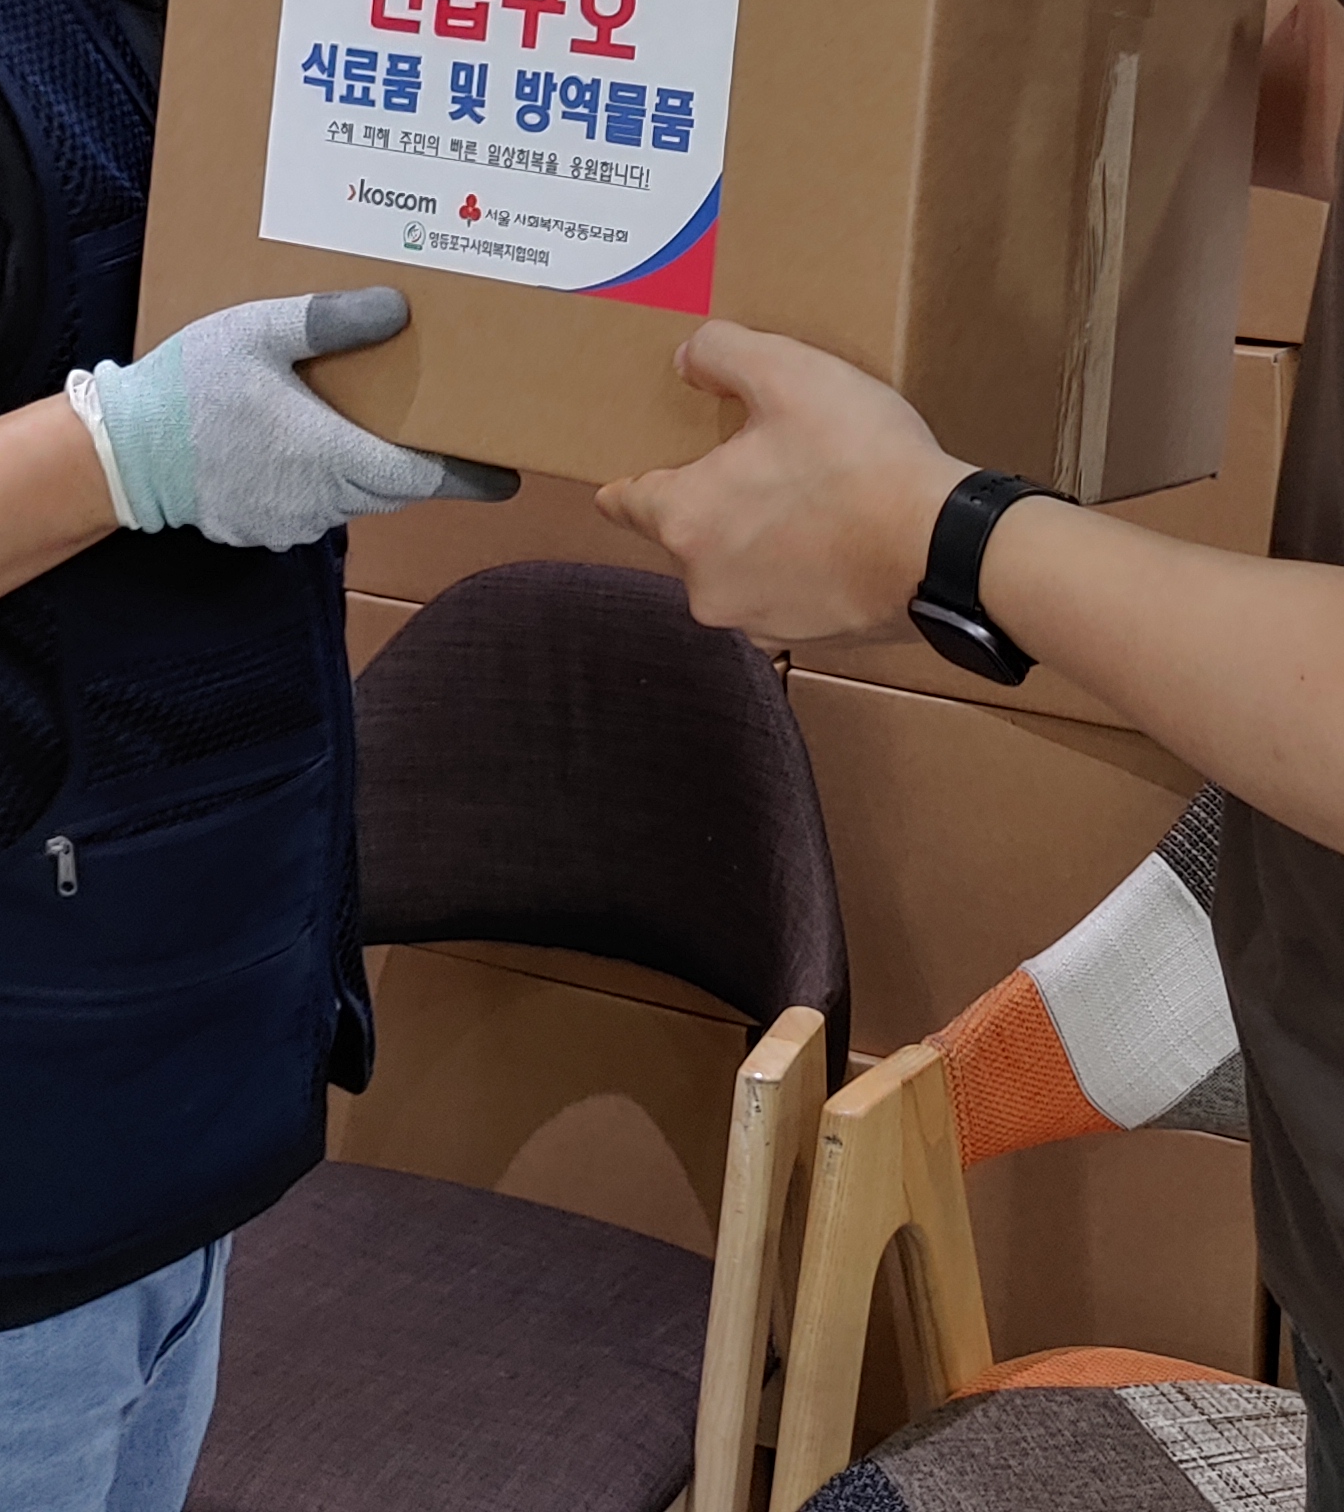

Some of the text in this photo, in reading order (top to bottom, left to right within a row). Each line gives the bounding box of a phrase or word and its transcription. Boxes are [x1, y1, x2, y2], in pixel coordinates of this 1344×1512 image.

[301, 41, 695, 154] 식료품 및 방역물품
[363, 125, 390, 148] 피해
[399, 130, 440, 156] 주민의
[449, 138, 478, 163] 빠른
[488, 144, 559, 176] 일상회복을
[569, 155, 652, 188] 응원합니다!
[358, 179, 437, 215] koscom
[485, 207, 629, 244] 서울 사회복지공동모금회
[428, 230, 550, 267] 영등포구사회복지협의회
